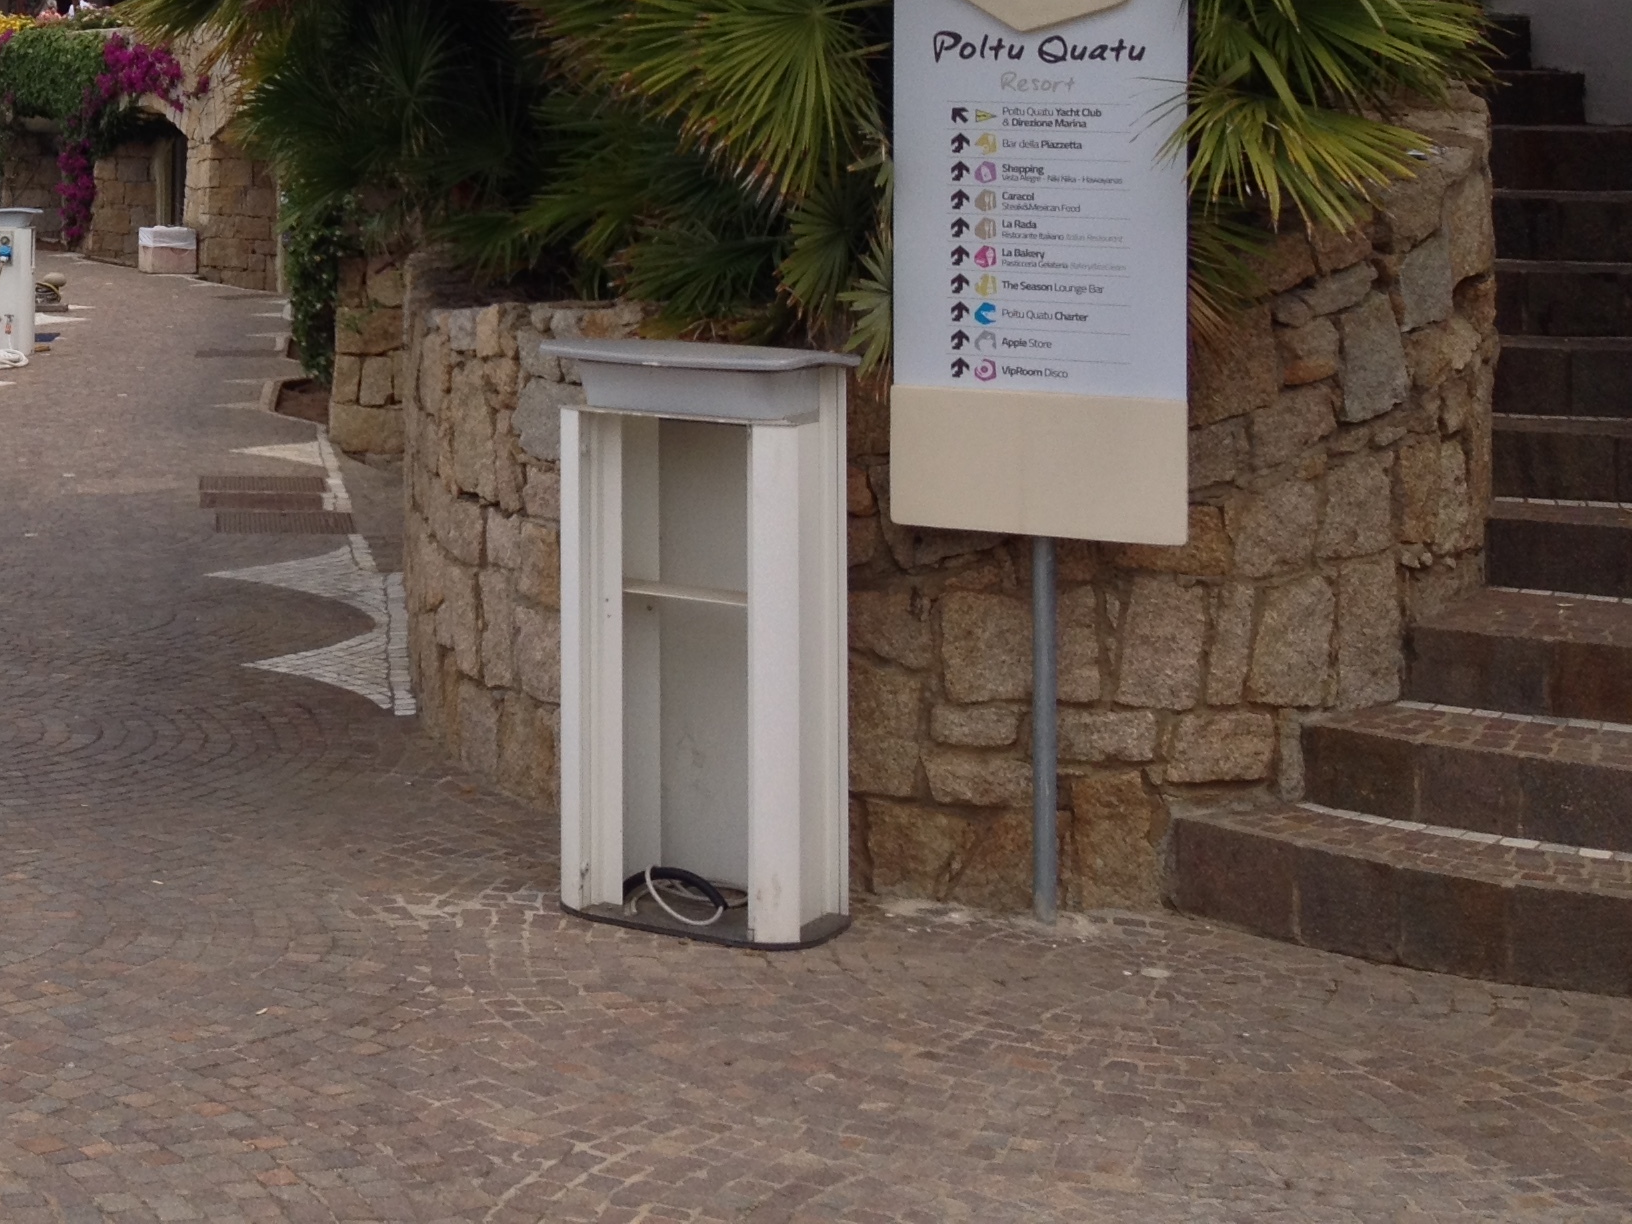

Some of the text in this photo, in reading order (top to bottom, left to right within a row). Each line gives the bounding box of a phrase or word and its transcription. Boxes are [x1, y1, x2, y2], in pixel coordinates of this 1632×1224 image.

[933, 30, 1146, 64] Poltu Quatu
[1000, 71, 1076, 93] Resort
[1002, 106, 1102, 118] Poltu Quatu Yacht Club
[1011, 118, 1053, 128] Direzione
[1054, 118, 1087, 128] Marina
[1002, 138, 1083, 150] Bar della Piazzetta
[1002, 163, 1045, 176] Shopping
[1002, 191, 1035, 201] Caracol
[1061, 203, 1081, 213] Food
[1002, 219, 1037, 229] La Rada
[1002, 248, 1045, 260] La Bakery
[1002, 280, 1104, 295] The Season Lounge Bar
[1002, 308, 1089, 321] Poltu Quatu Charter
[1002, 337, 1052, 349] Apple Store
[1002, 365, 1068, 378] VipRoom Disco
